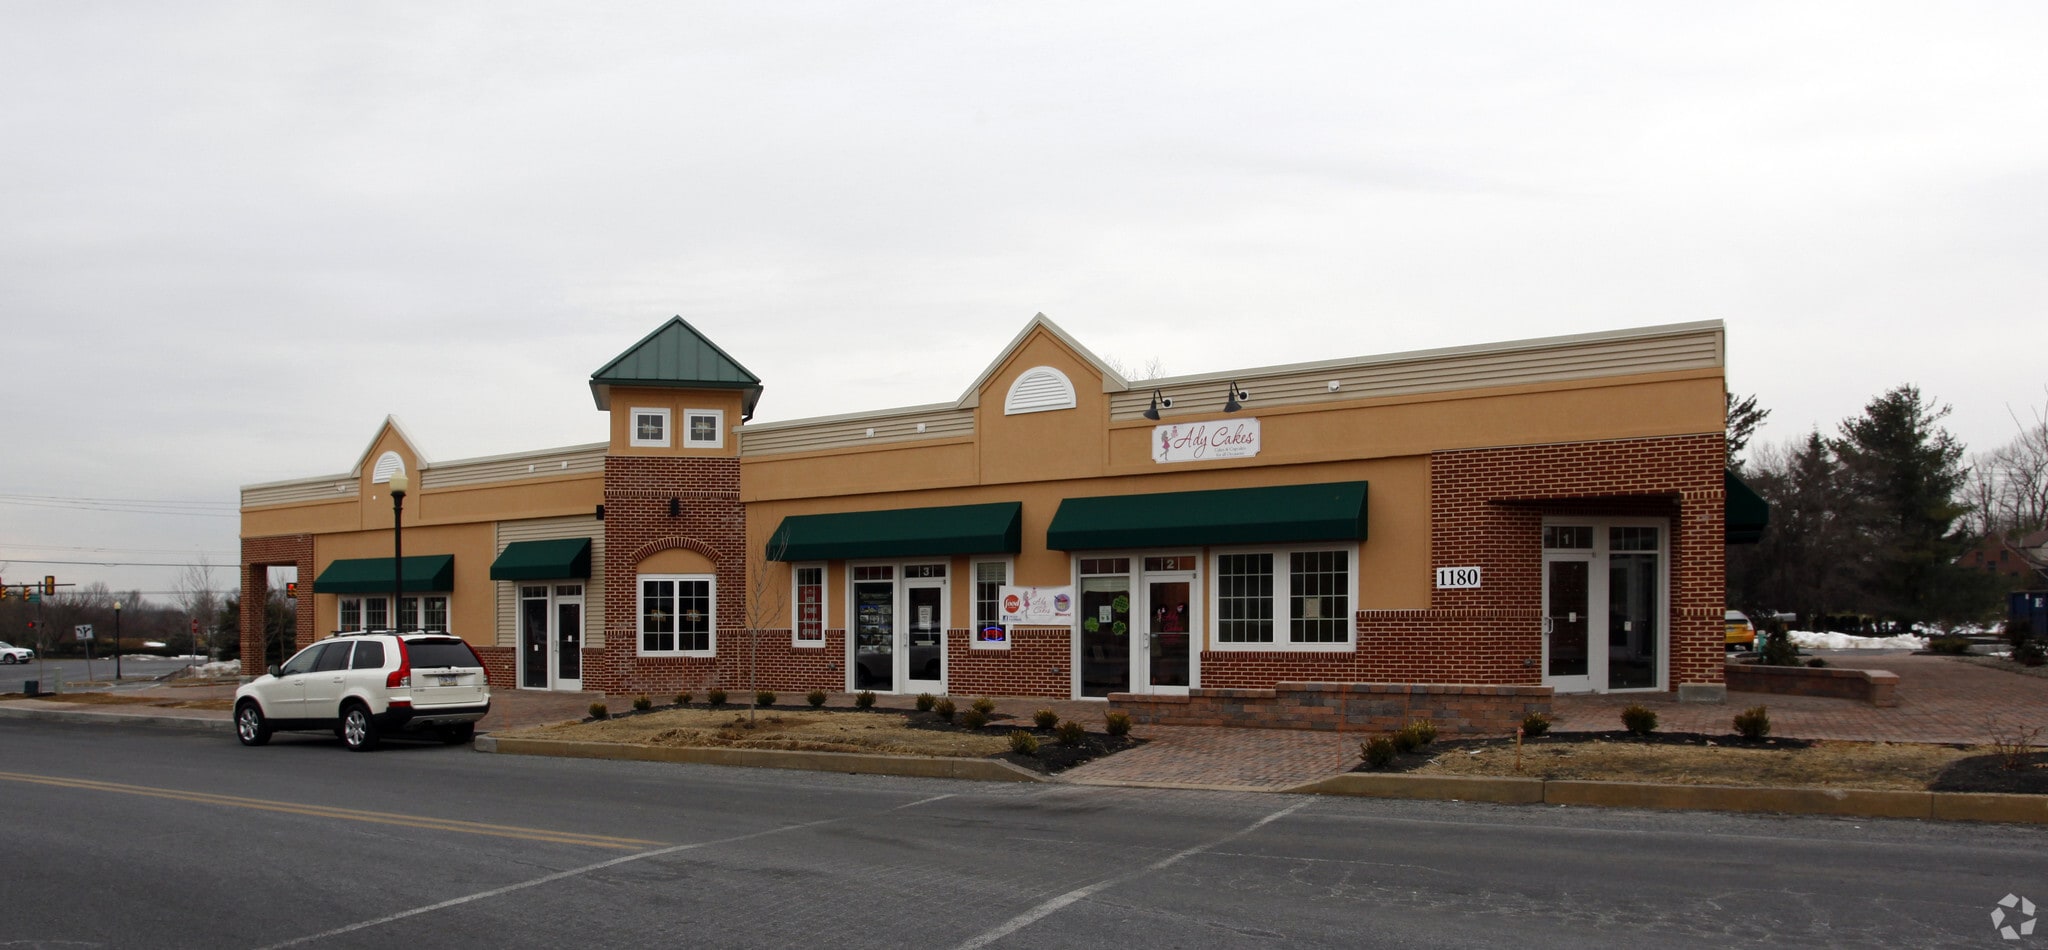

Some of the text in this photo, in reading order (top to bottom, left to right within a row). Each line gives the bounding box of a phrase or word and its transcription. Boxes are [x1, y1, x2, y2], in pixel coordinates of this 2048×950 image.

[1174, 423, 1254, 458] Ady Cakes
[1167, 559, 1174, 569] 2
[923, 567, 930, 576] 3
[1439, 569, 1478, 586] 1180
